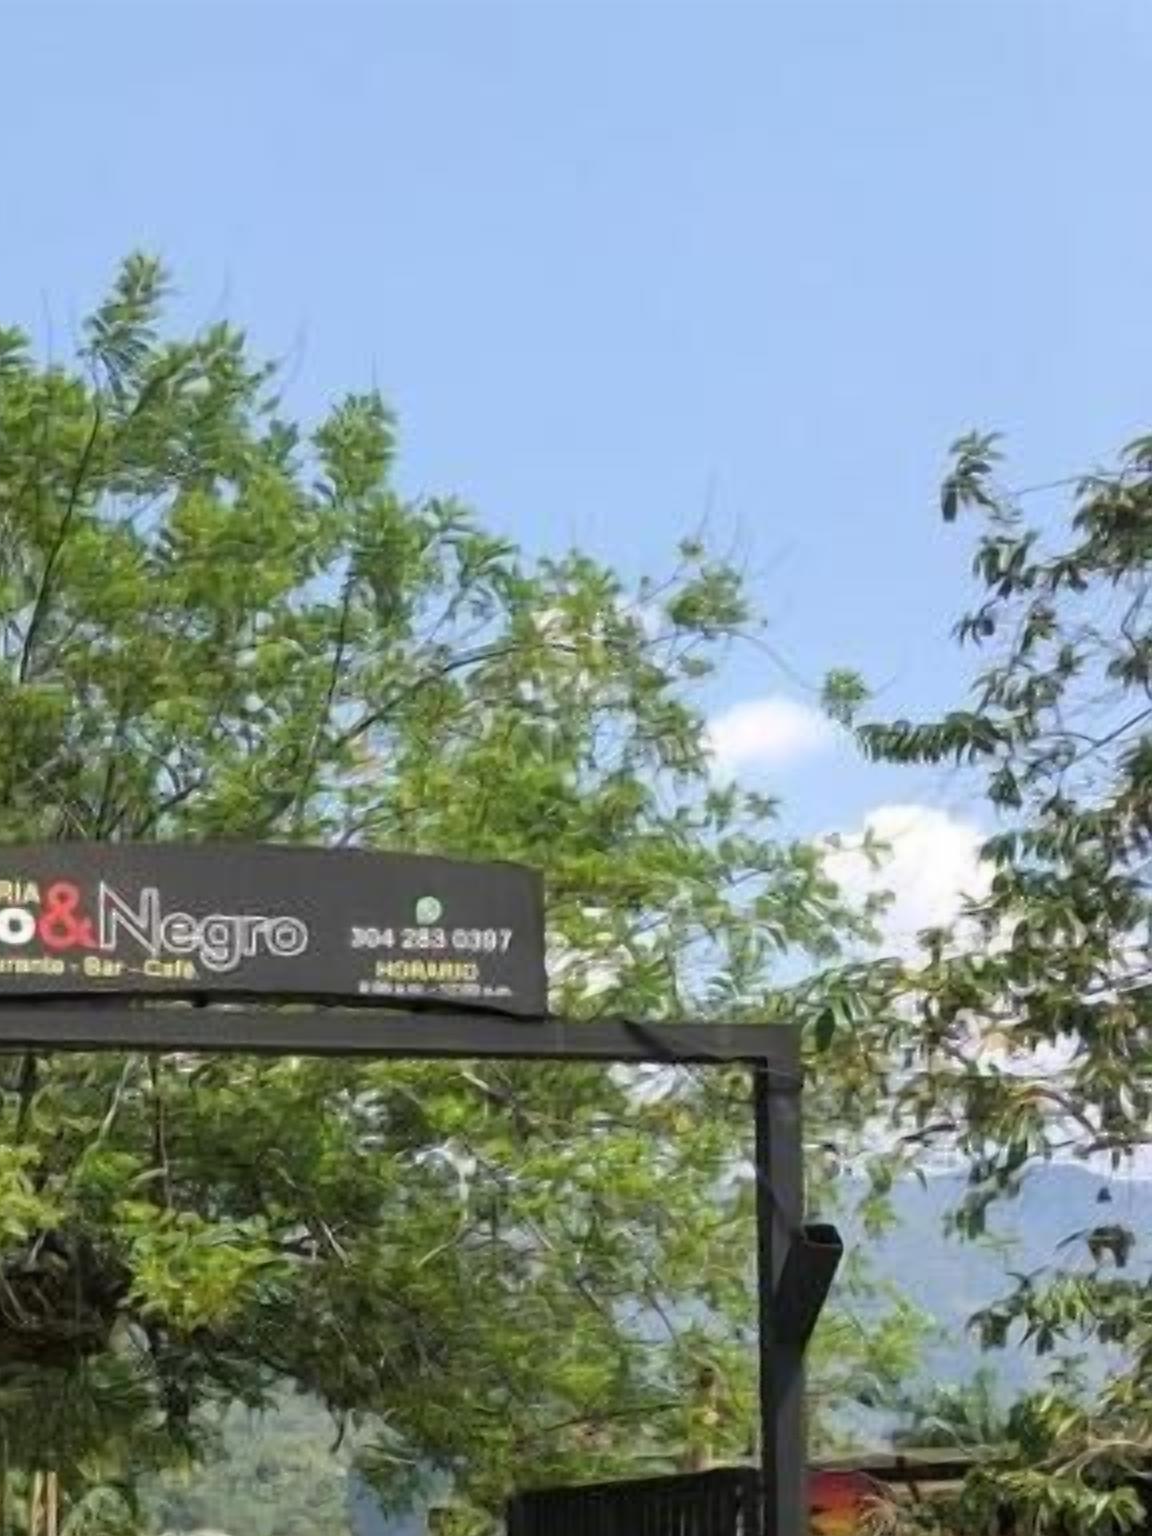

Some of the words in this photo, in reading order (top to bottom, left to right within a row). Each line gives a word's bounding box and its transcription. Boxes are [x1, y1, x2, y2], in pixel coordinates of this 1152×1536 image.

[38, 881, 98, 950] &
[99, 880, 308, 971] Negro
[84, 957, 125, 976] Bar
